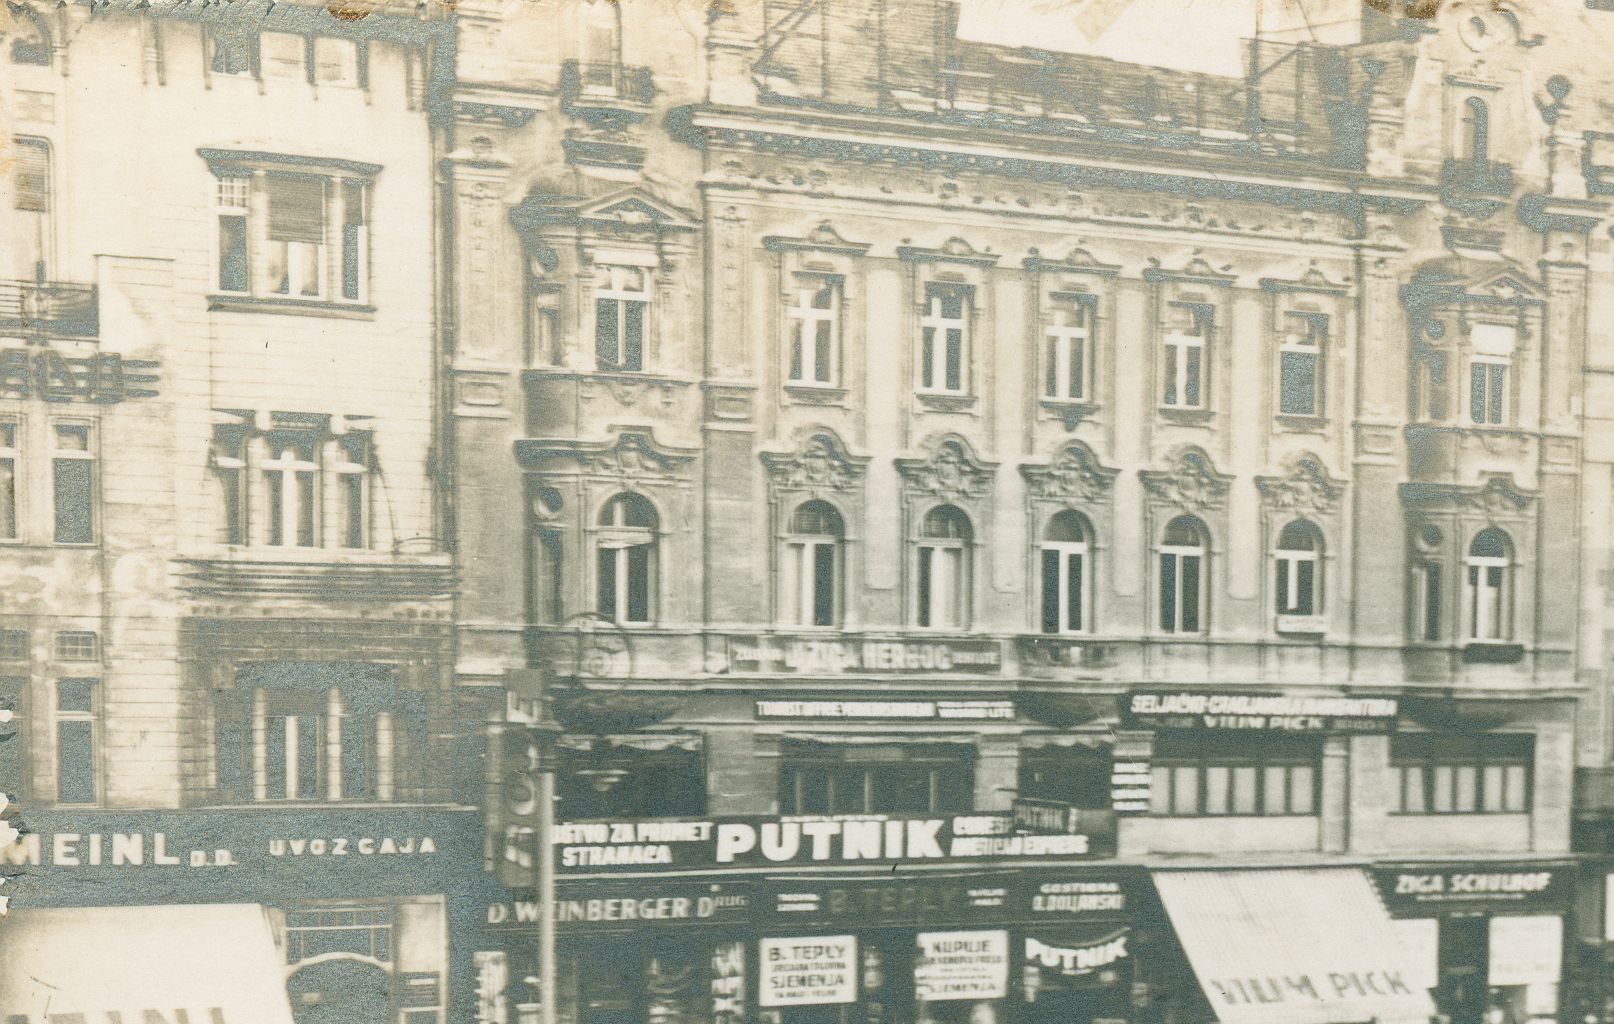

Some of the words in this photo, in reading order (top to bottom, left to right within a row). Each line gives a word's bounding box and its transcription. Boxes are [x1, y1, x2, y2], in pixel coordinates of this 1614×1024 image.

[2, 832, 180, 866] MEINL
[269, 838, 349, 856] UVOZ
[716, 819, 945, 862] PUTNIK
[562, 845, 673, 866] STRANACA
[791, 945, 846, 960] TEPLY
[1024, 936, 1129, 970] PUTNIK
[1328, 971, 1411, 999] PICK
